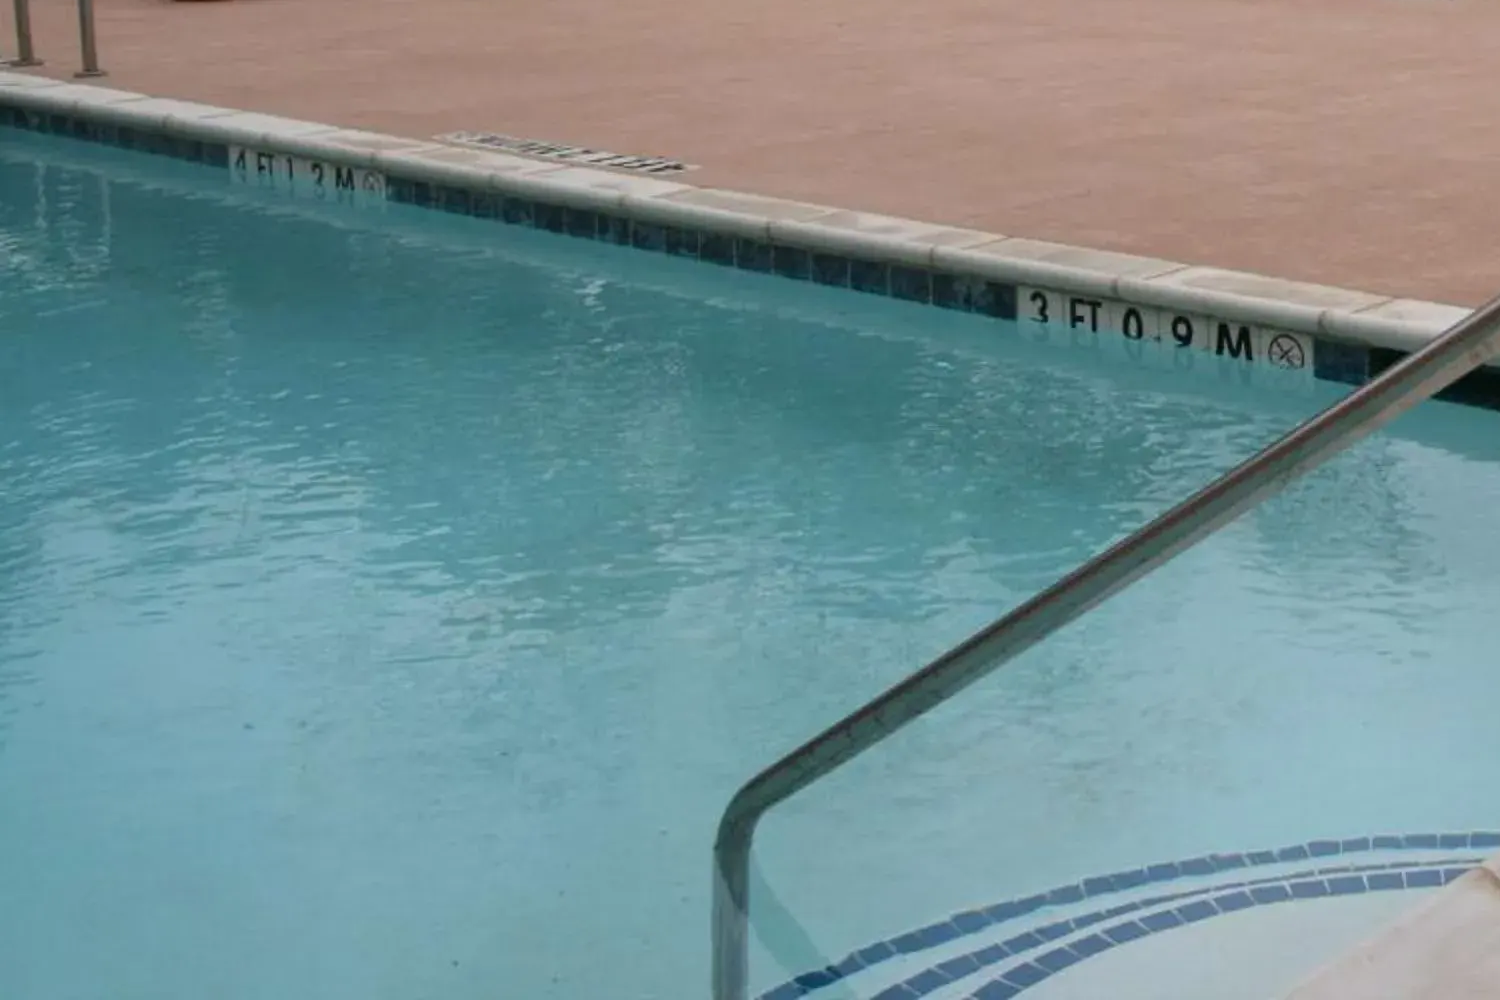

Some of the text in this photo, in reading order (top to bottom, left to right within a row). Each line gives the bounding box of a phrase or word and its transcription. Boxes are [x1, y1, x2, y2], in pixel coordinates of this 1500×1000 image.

[1029, 290, 1050, 323] 3
[1068, 298, 1103, 333] FT
[1215, 322, 1253, 361] M
